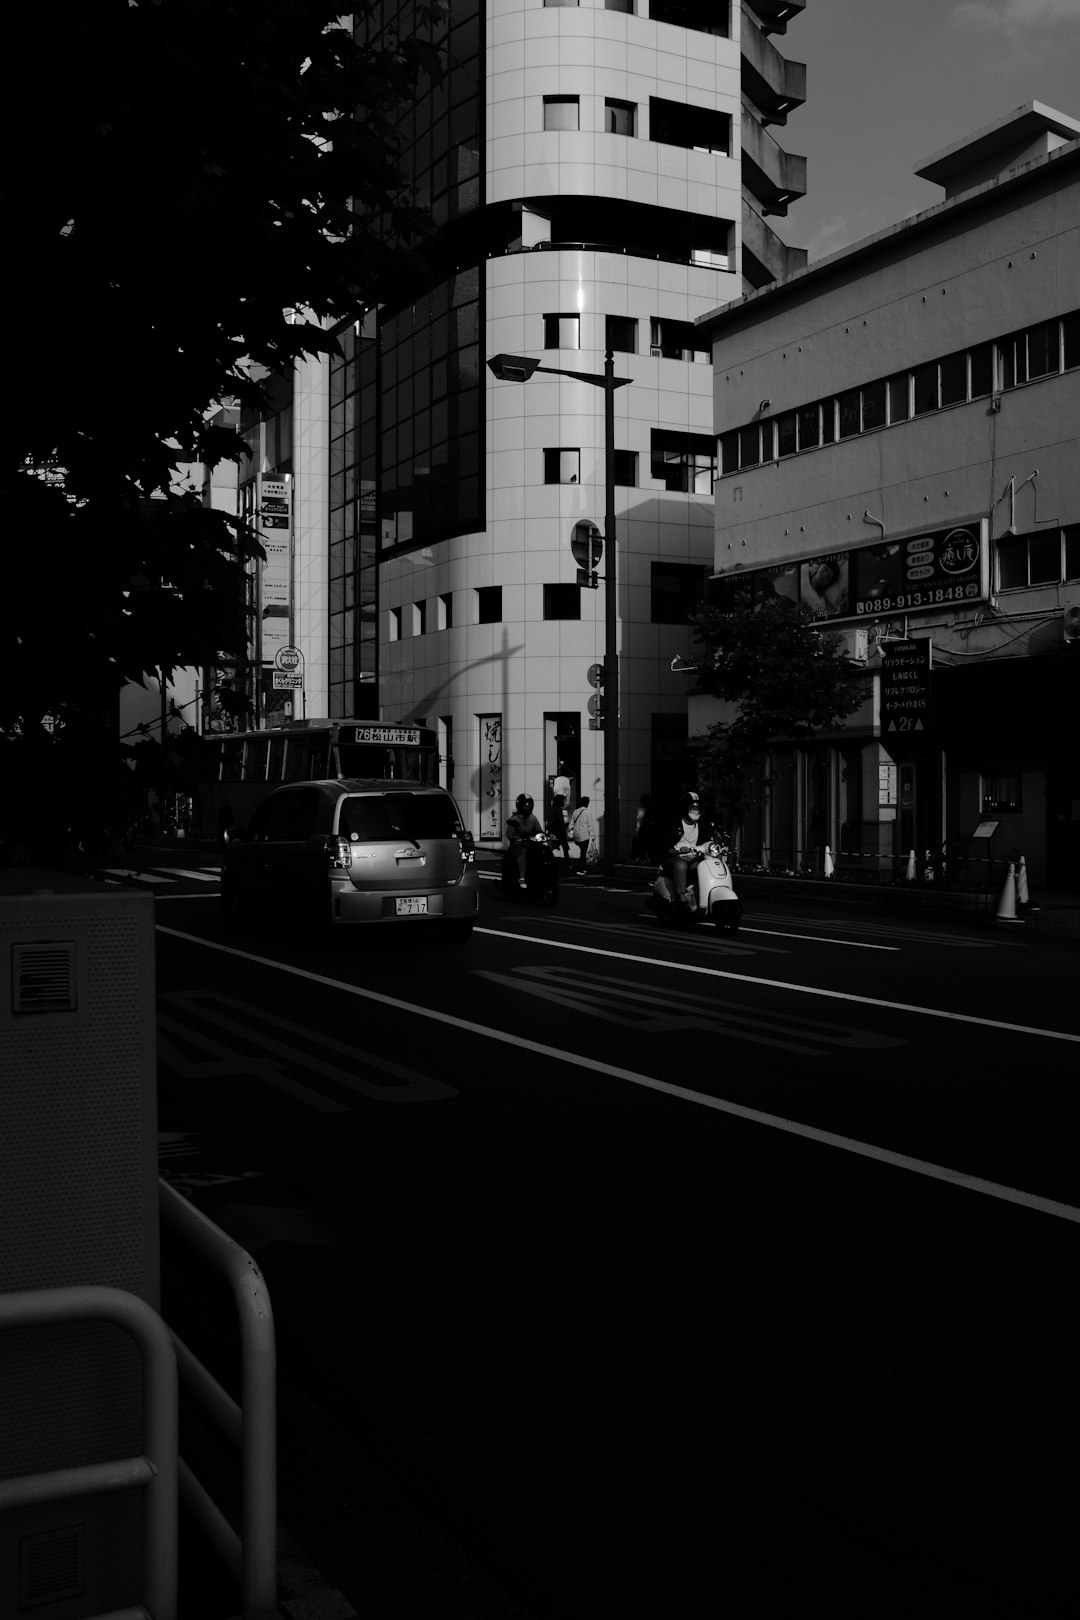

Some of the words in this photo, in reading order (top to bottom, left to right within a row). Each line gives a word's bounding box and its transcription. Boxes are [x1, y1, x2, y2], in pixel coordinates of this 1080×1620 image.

[865, 585, 964, 613] 089-913-1848
[884, 655, 926, 668] リラクゼーション
[884, 684, 926, 696] リフレクソロジー
[899, 716, 914, 731] 2F
[358, 729, 370, 740] 76
[371, 733, 418, 742] 松山市駅
